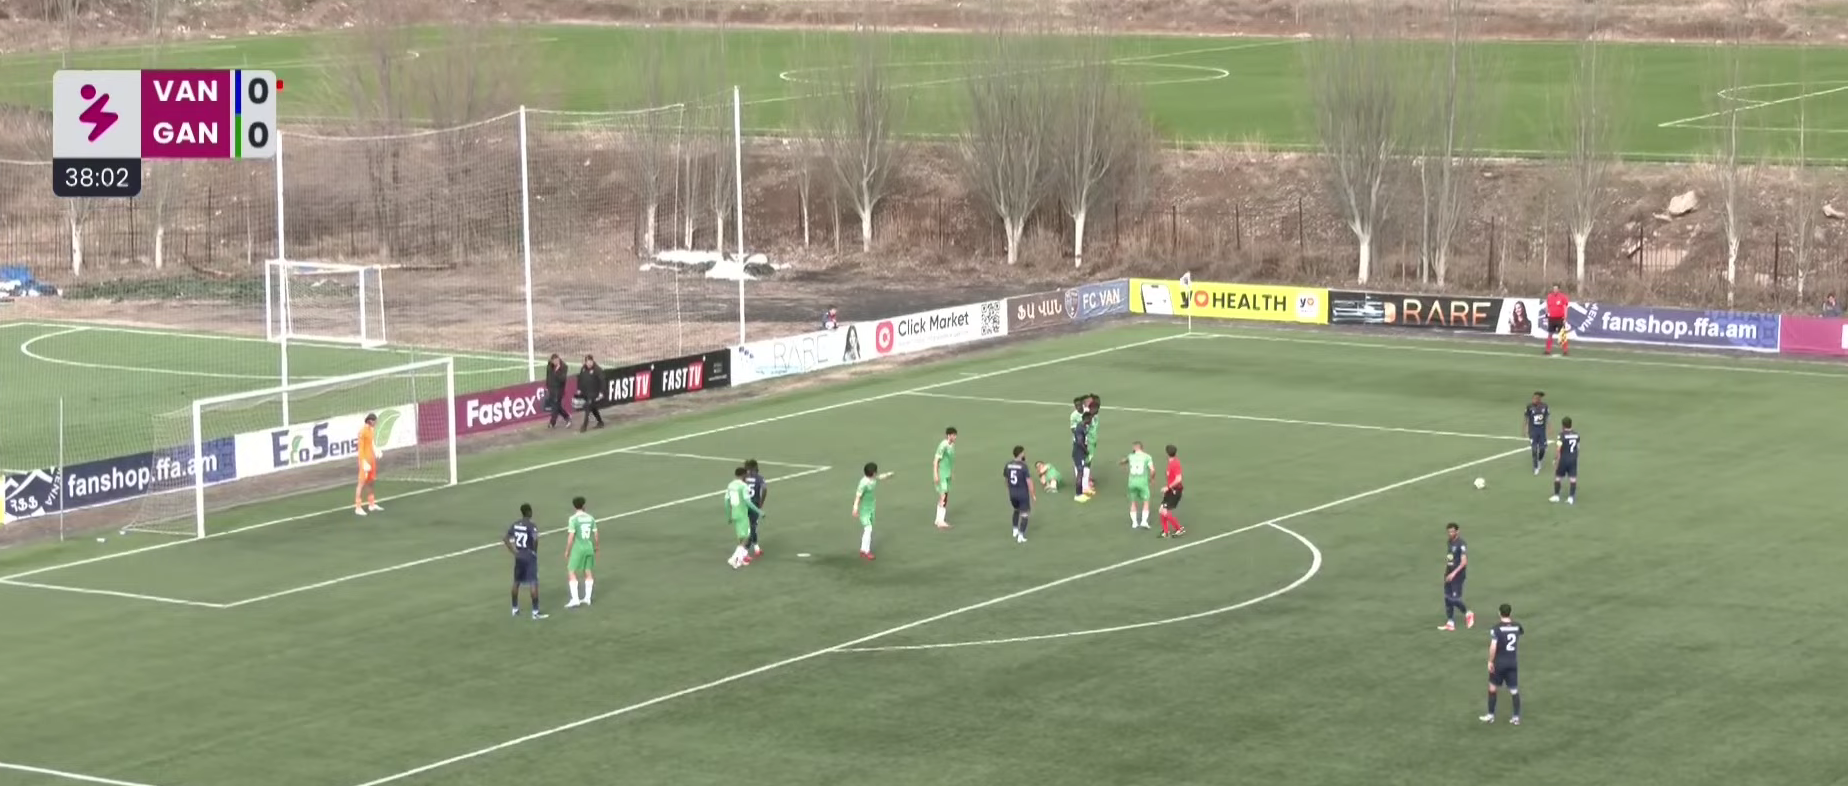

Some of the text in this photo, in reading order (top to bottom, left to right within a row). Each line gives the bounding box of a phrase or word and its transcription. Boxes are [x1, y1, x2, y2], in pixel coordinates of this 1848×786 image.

[1082, 288, 1121, 310] FC VAN
[898, 311, 969, 337] Click Market
[1602, 312, 1757, 340] fanshop.ffa.am
[466, 396, 537, 428] Fastex
[1568, 438, 1577, 453] 7
[68, 454, 217, 498] fanshop.ffa.am
[1010, 469, 1018, 485] 5
[514, 531, 528, 548] 27
[1505, 633, 1517, 651] 2
